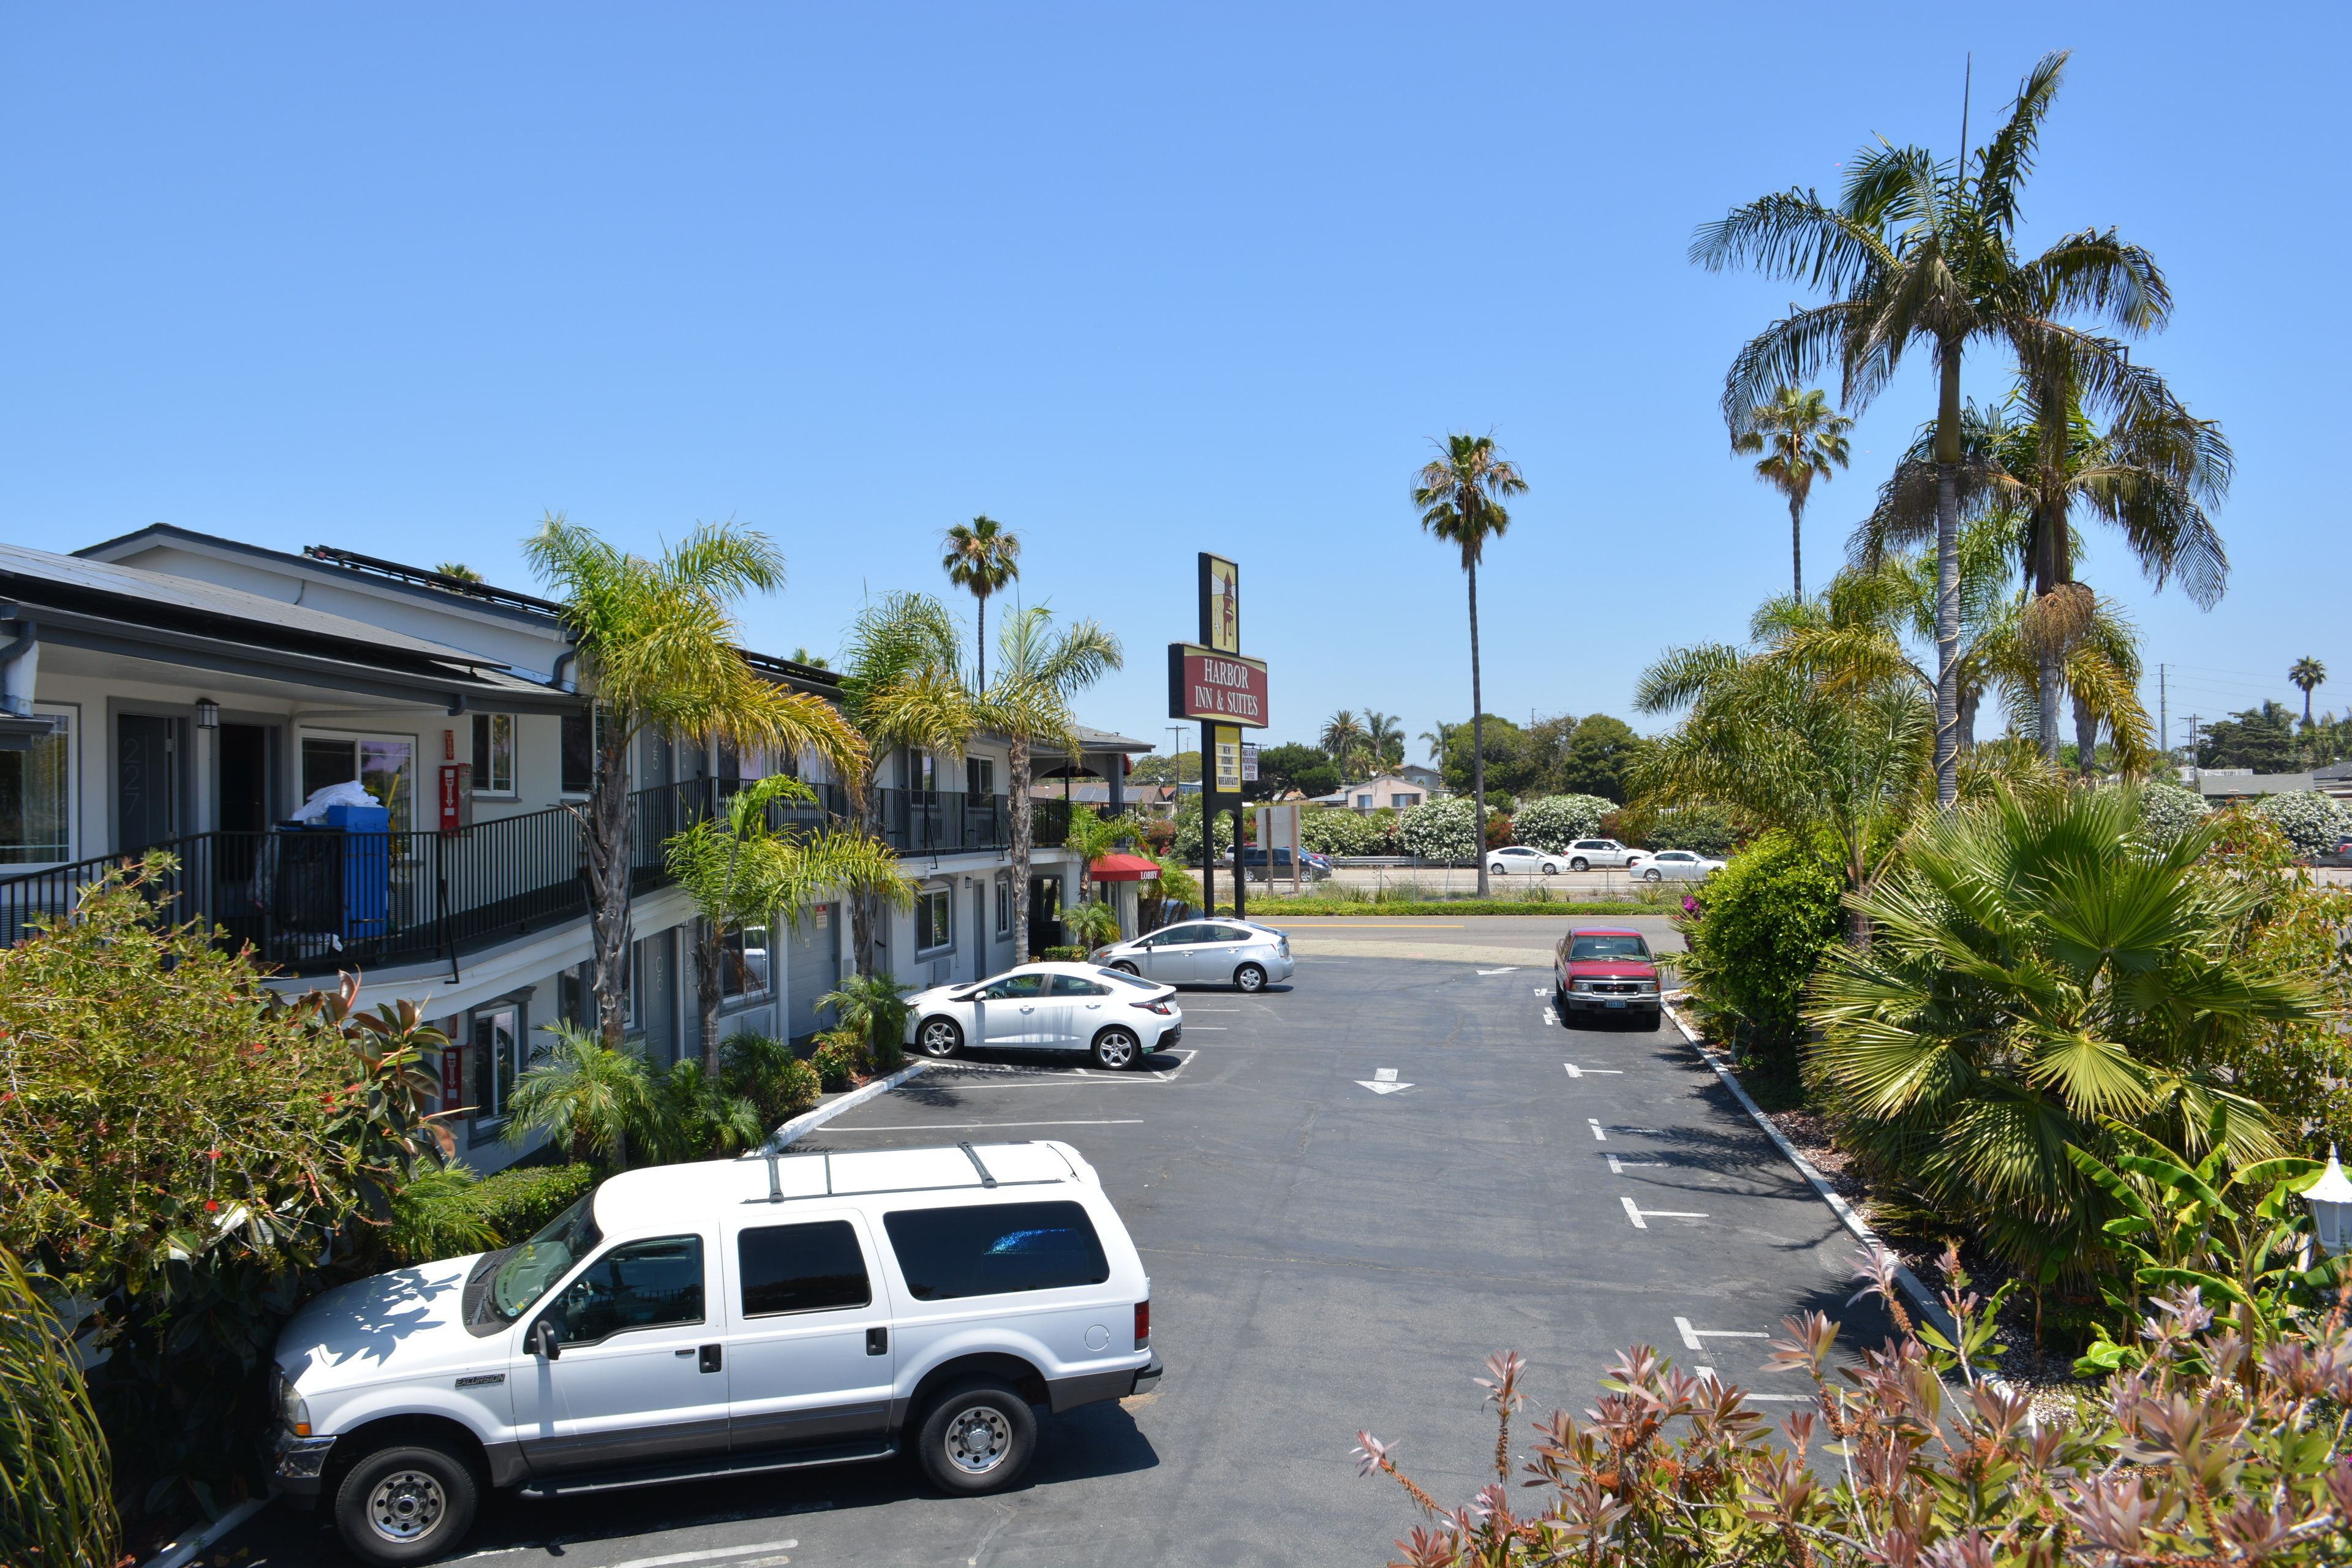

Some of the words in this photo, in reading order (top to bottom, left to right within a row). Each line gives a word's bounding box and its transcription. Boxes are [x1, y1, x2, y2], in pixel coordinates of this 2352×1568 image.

[1204, 658, 1249, 689] HARBOR
[1195, 685, 1213, 709] INN
[1216, 690, 1224, 711] &
[1227, 692, 1258, 716] SUITES
[1223, 767, 1232, 775] FREE
[123, 738, 140, 818] 227
[1218, 777, 1238, 785] BREAKFAST
[1140, 870, 1158, 880] LOBBY
[455, 1374, 505, 1387] EXCURSION
